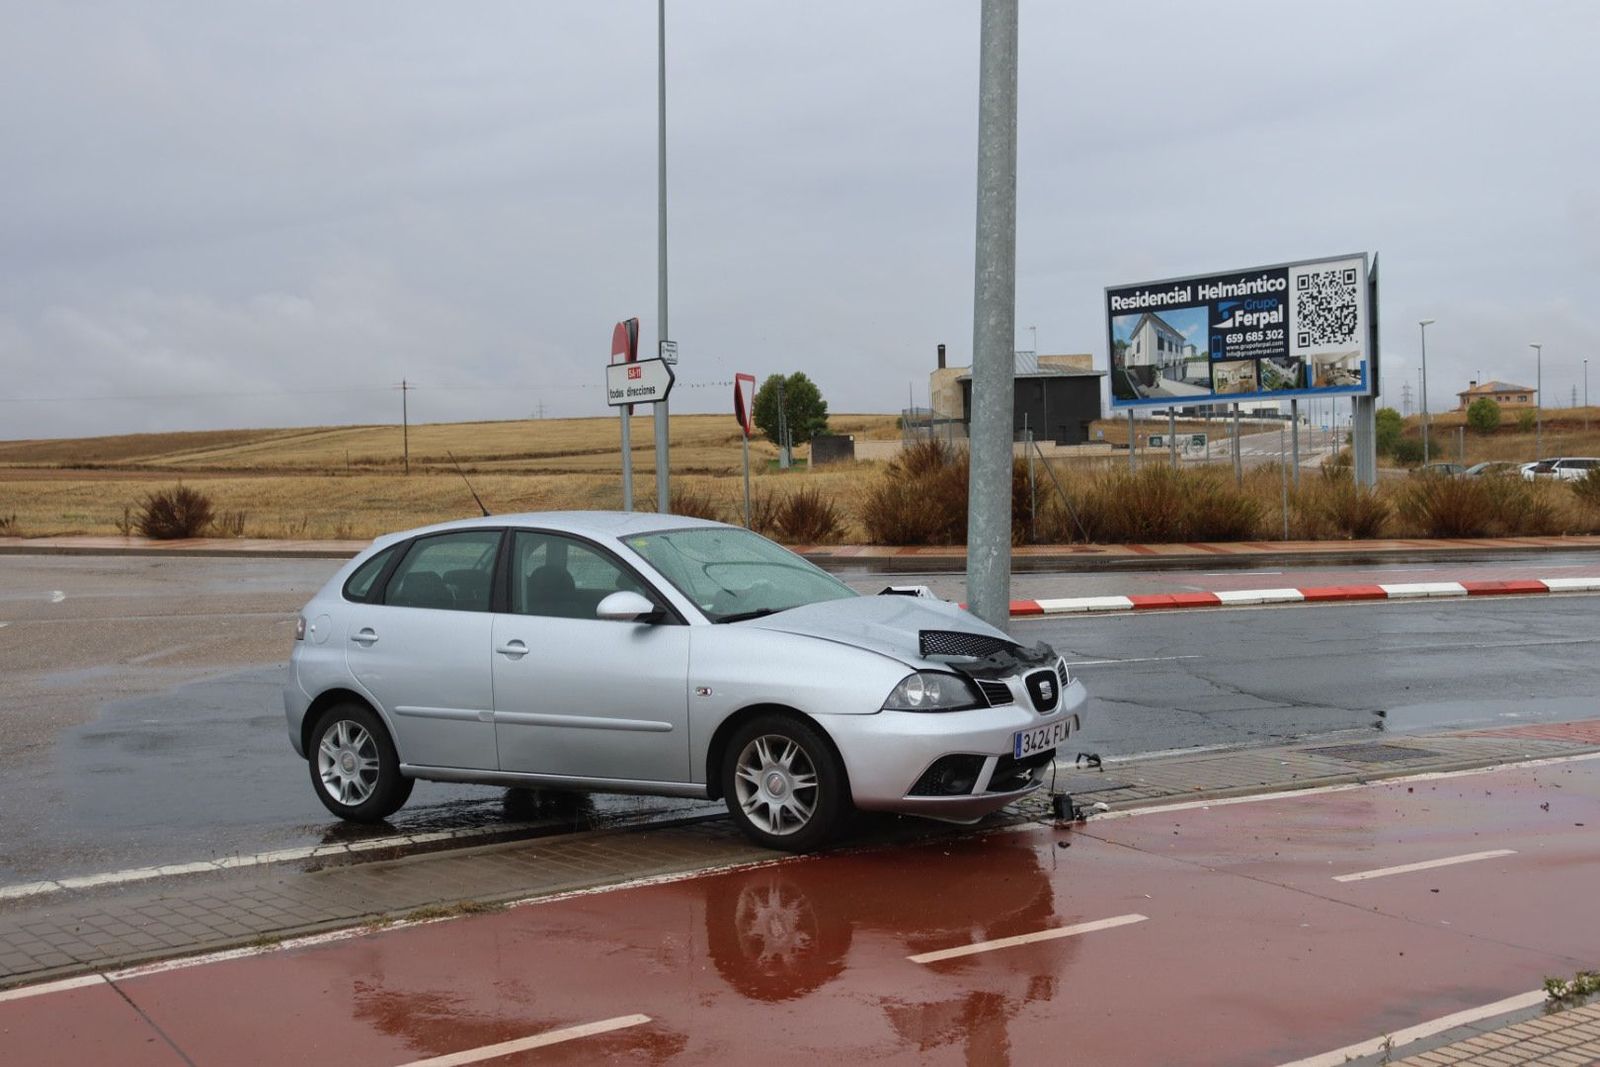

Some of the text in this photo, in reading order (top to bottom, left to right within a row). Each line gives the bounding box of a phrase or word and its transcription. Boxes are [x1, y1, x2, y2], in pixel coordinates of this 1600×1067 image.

[1111, 274, 1287, 311] Residencial Helmántico
[1244, 298, 1278, 311] Grupo
[1234, 304, 1284, 329] Ferpal
[1226, 329, 1284, 344] 659 685 302
[609, 385, 656, 399] todas direcciones
[1023, 727, 1050, 754] 3424
